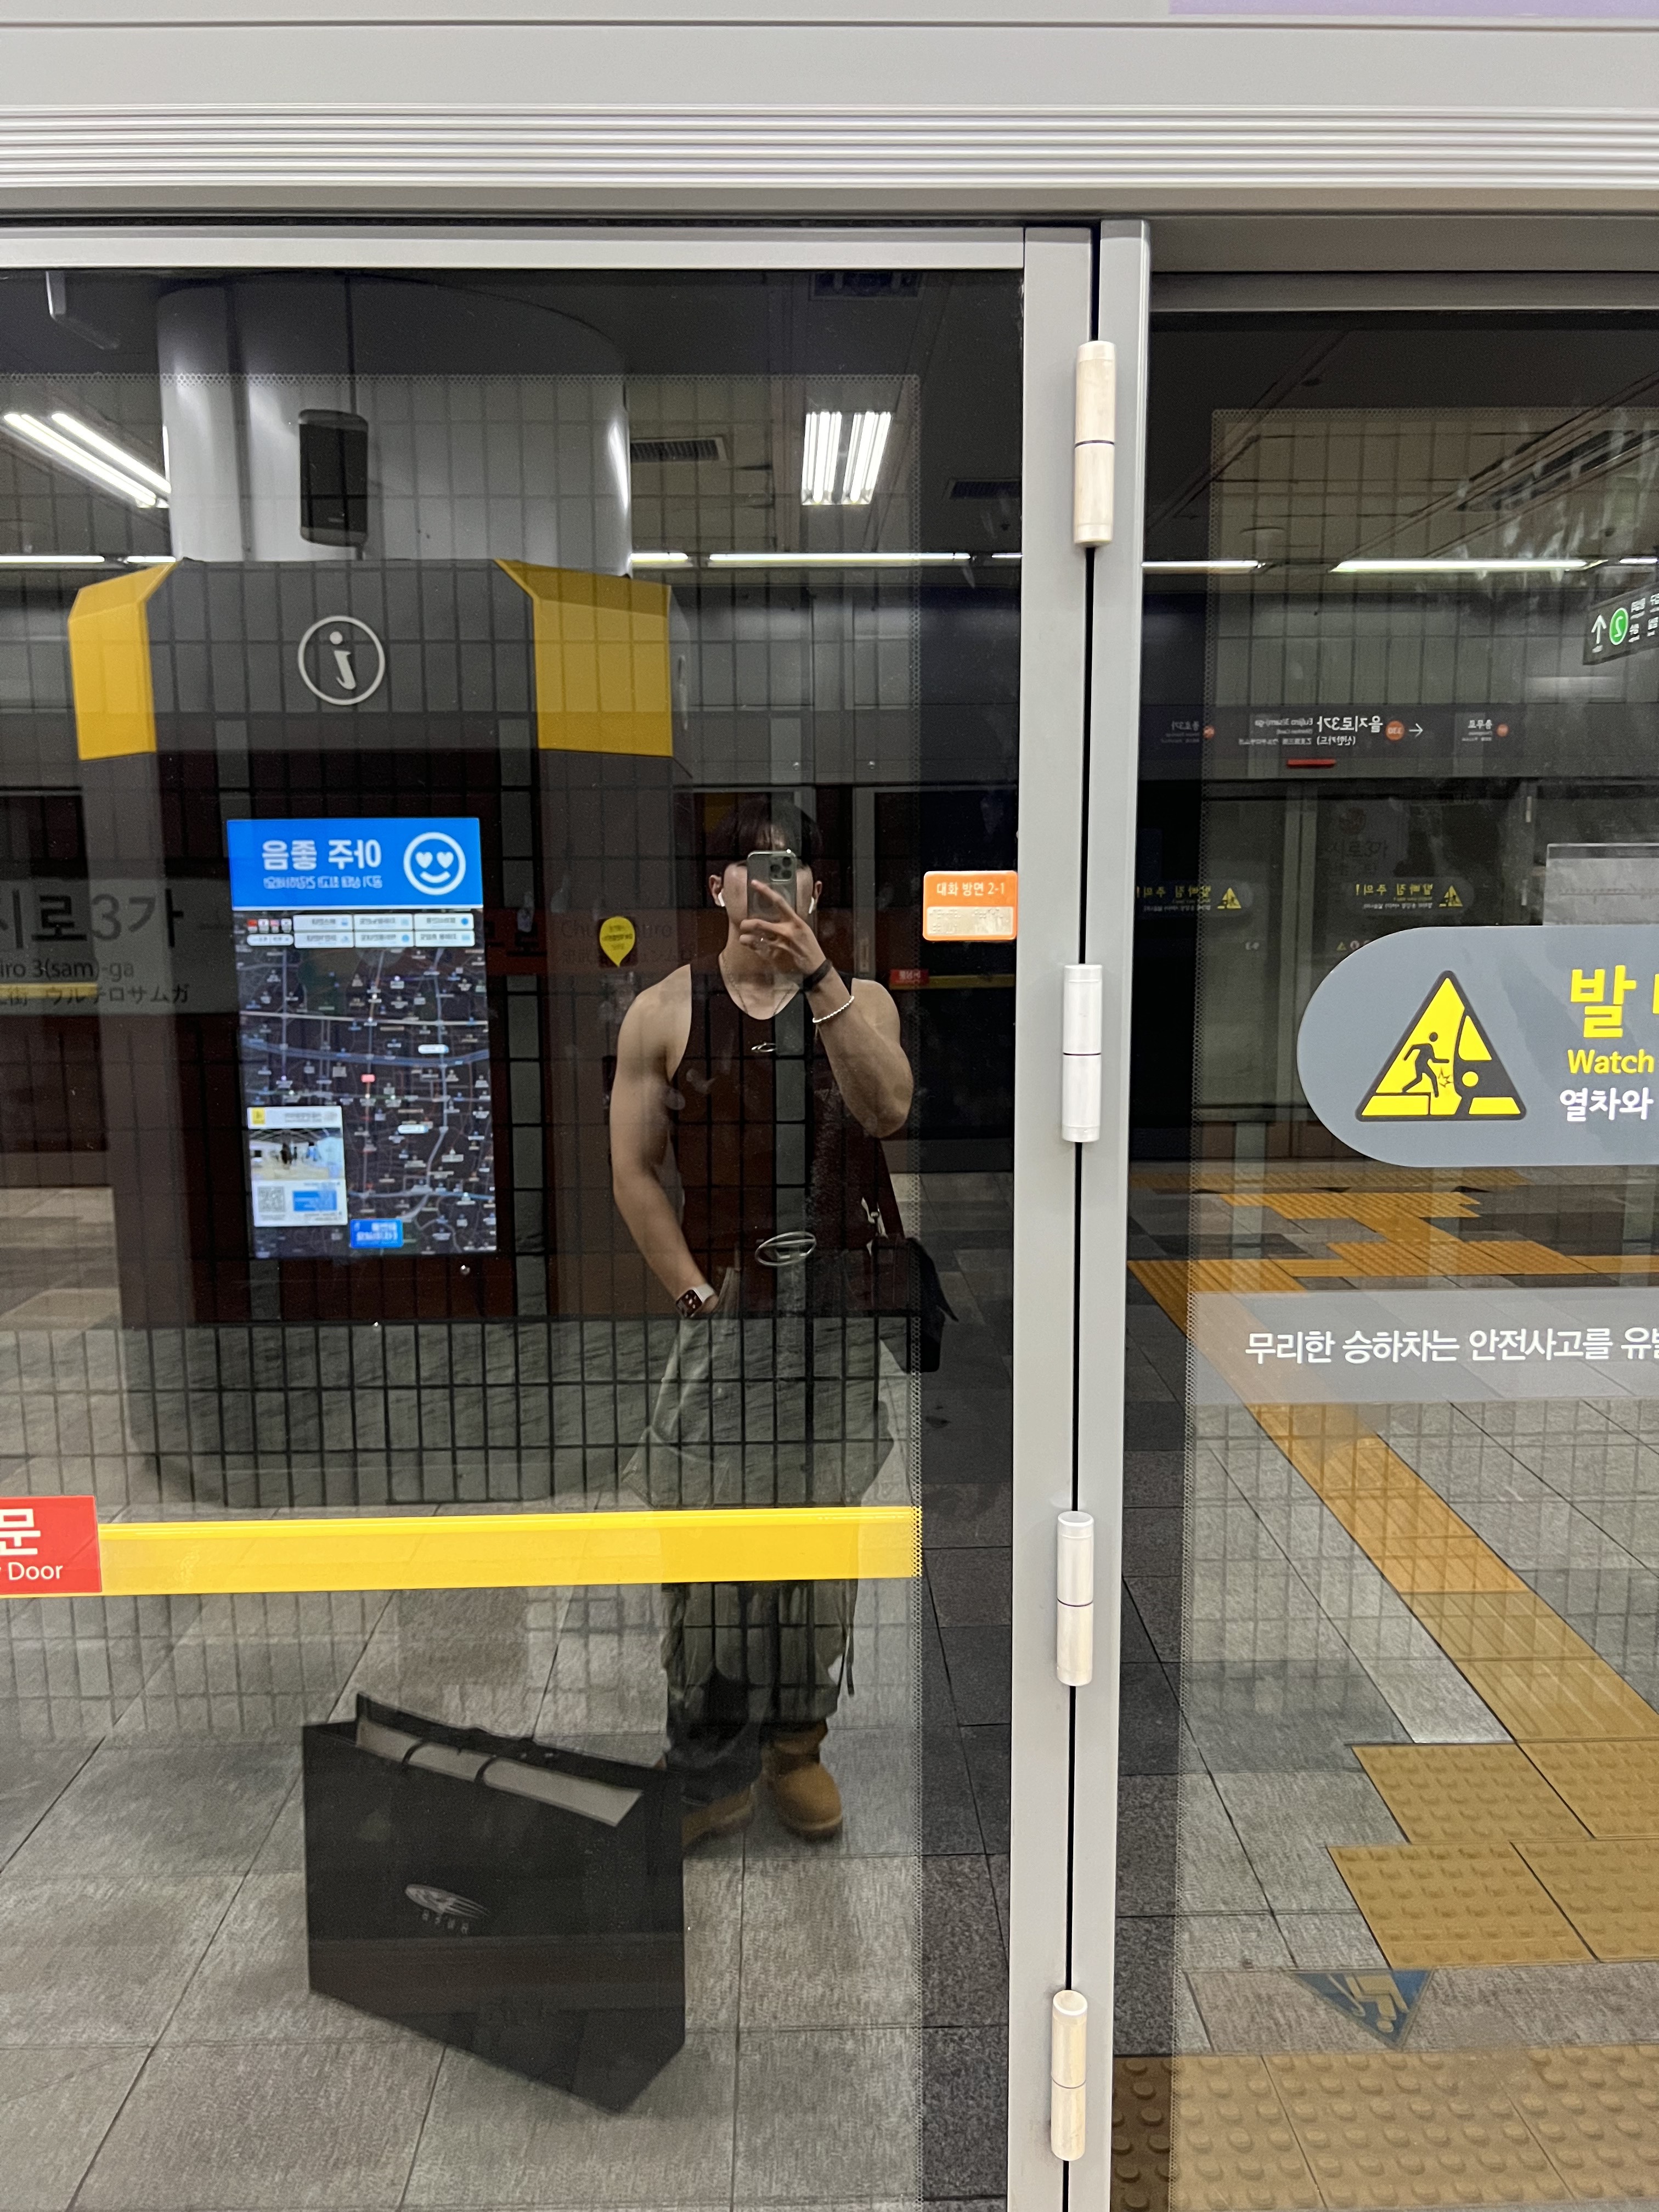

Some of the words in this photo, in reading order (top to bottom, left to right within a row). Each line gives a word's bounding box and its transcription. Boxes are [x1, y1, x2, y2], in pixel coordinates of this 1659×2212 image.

[936, 882, 958, 896] 대화
[987, 882, 1005, 895] 2-1
[31, 959, 135, 983] 3(sam)-ga
[1571, 964, 1659, 1038] 발
[1567, 1048, 1655, 1074] Watch
[1560, 1087, 1654, 1122] 열차와
[1245, 1330, 1336, 1364] 무리한
[1342, 1329, 1460, 1363] 승하차는
[1468, 1327, 1613, 1362] 안전사고를
[8, 1562, 64, 1581] Door
